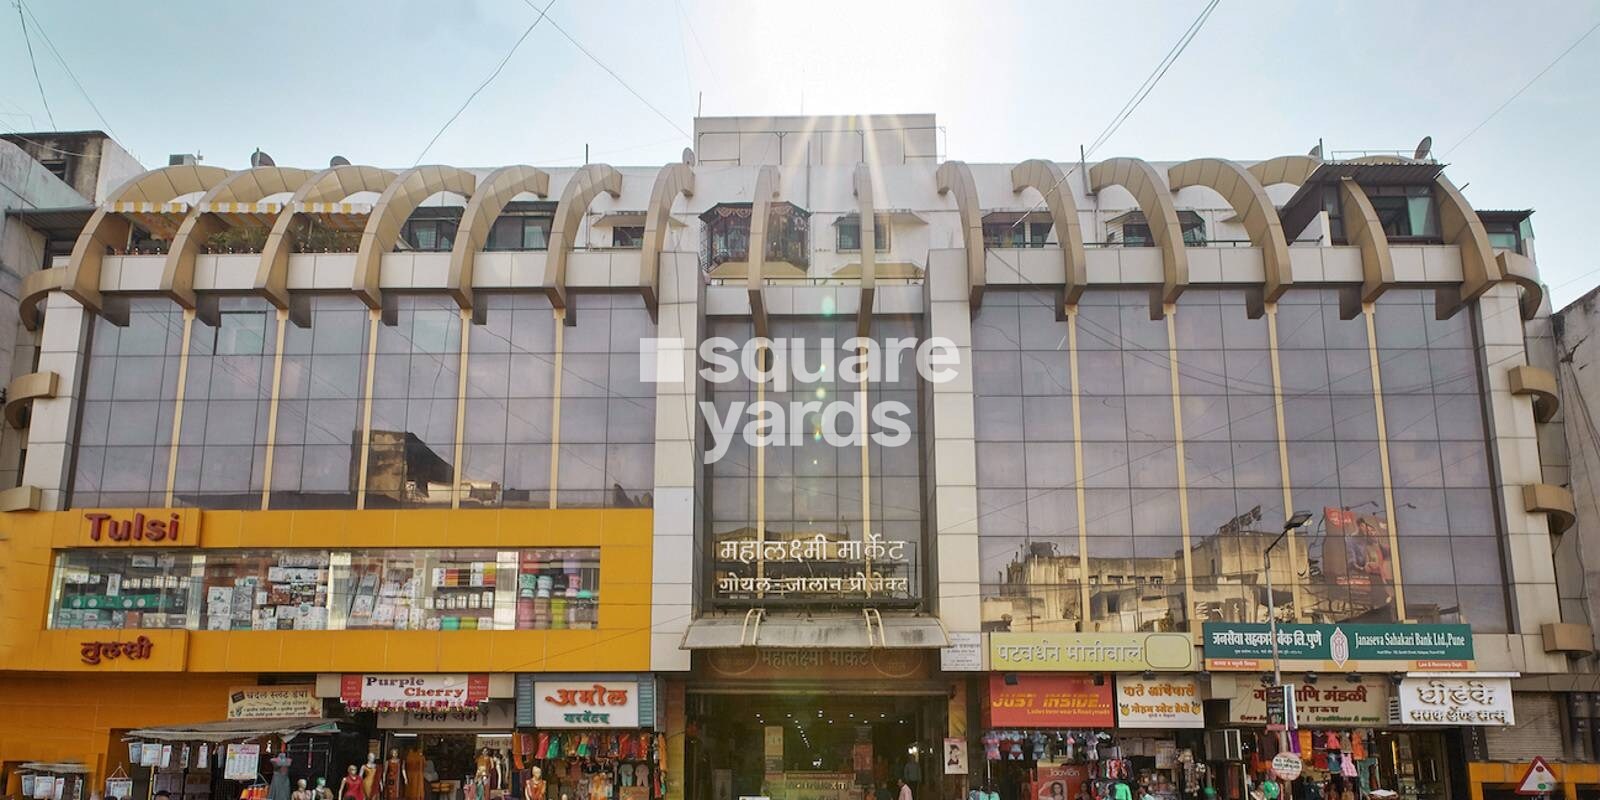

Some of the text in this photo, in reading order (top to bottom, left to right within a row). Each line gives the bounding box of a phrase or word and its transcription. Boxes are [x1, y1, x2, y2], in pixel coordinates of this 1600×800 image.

[85, 512, 181, 542] Tulsi
[720, 533, 906, 564] महालक्ष्मी मार्केट
[1212, 629, 1243, 645] जनसेवा
[1244, 632, 1273, 647] सहकार
[1355, 632, 1384, 648] Janaseva
[1385, 632, 1415, 646] Sahakari
[1415, 632, 1433, 646] Bank
[80, 635, 154, 665] तुलसी
[997, 640, 1061, 663] पटवर्धन
[1065, 640, 1144, 663] मोतीवाले
[366, 677, 425, 688] Purple
[403, 687, 465, 698] Cherry
[545, 684, 628, 707] अमोल
[992, 692, 1037, 708] JUST
[1324, 685, 1368, 702] मंडळी
